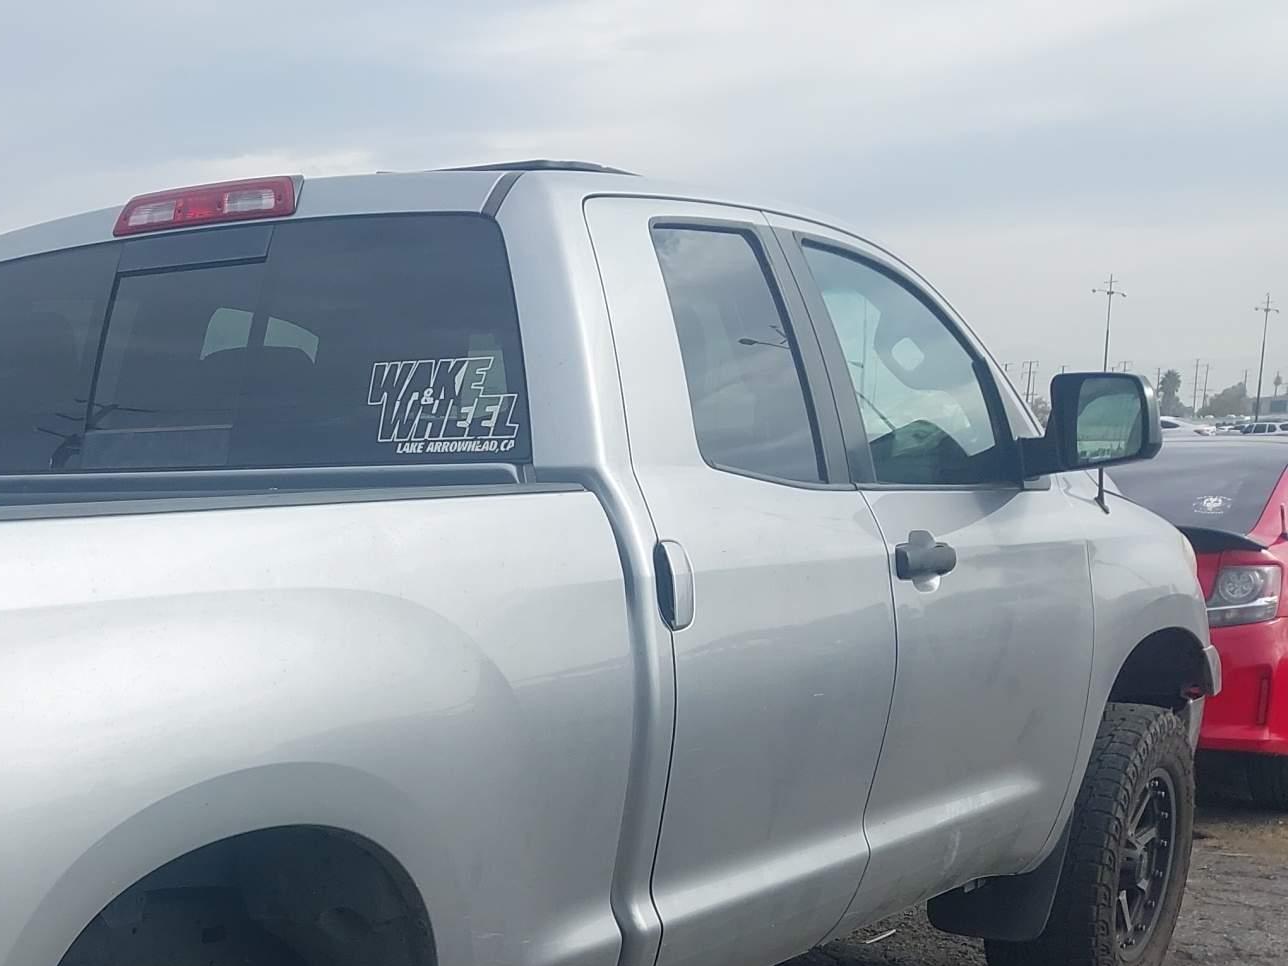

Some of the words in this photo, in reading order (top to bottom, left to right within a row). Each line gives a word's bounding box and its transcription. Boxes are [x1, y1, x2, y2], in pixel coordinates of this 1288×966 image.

[368, 357, 494, 406] WAKE
[421, 388, 434, 404] &
[378, 392, 519, 442] WHEEL
[396, 442, 424, 454] LAKE
